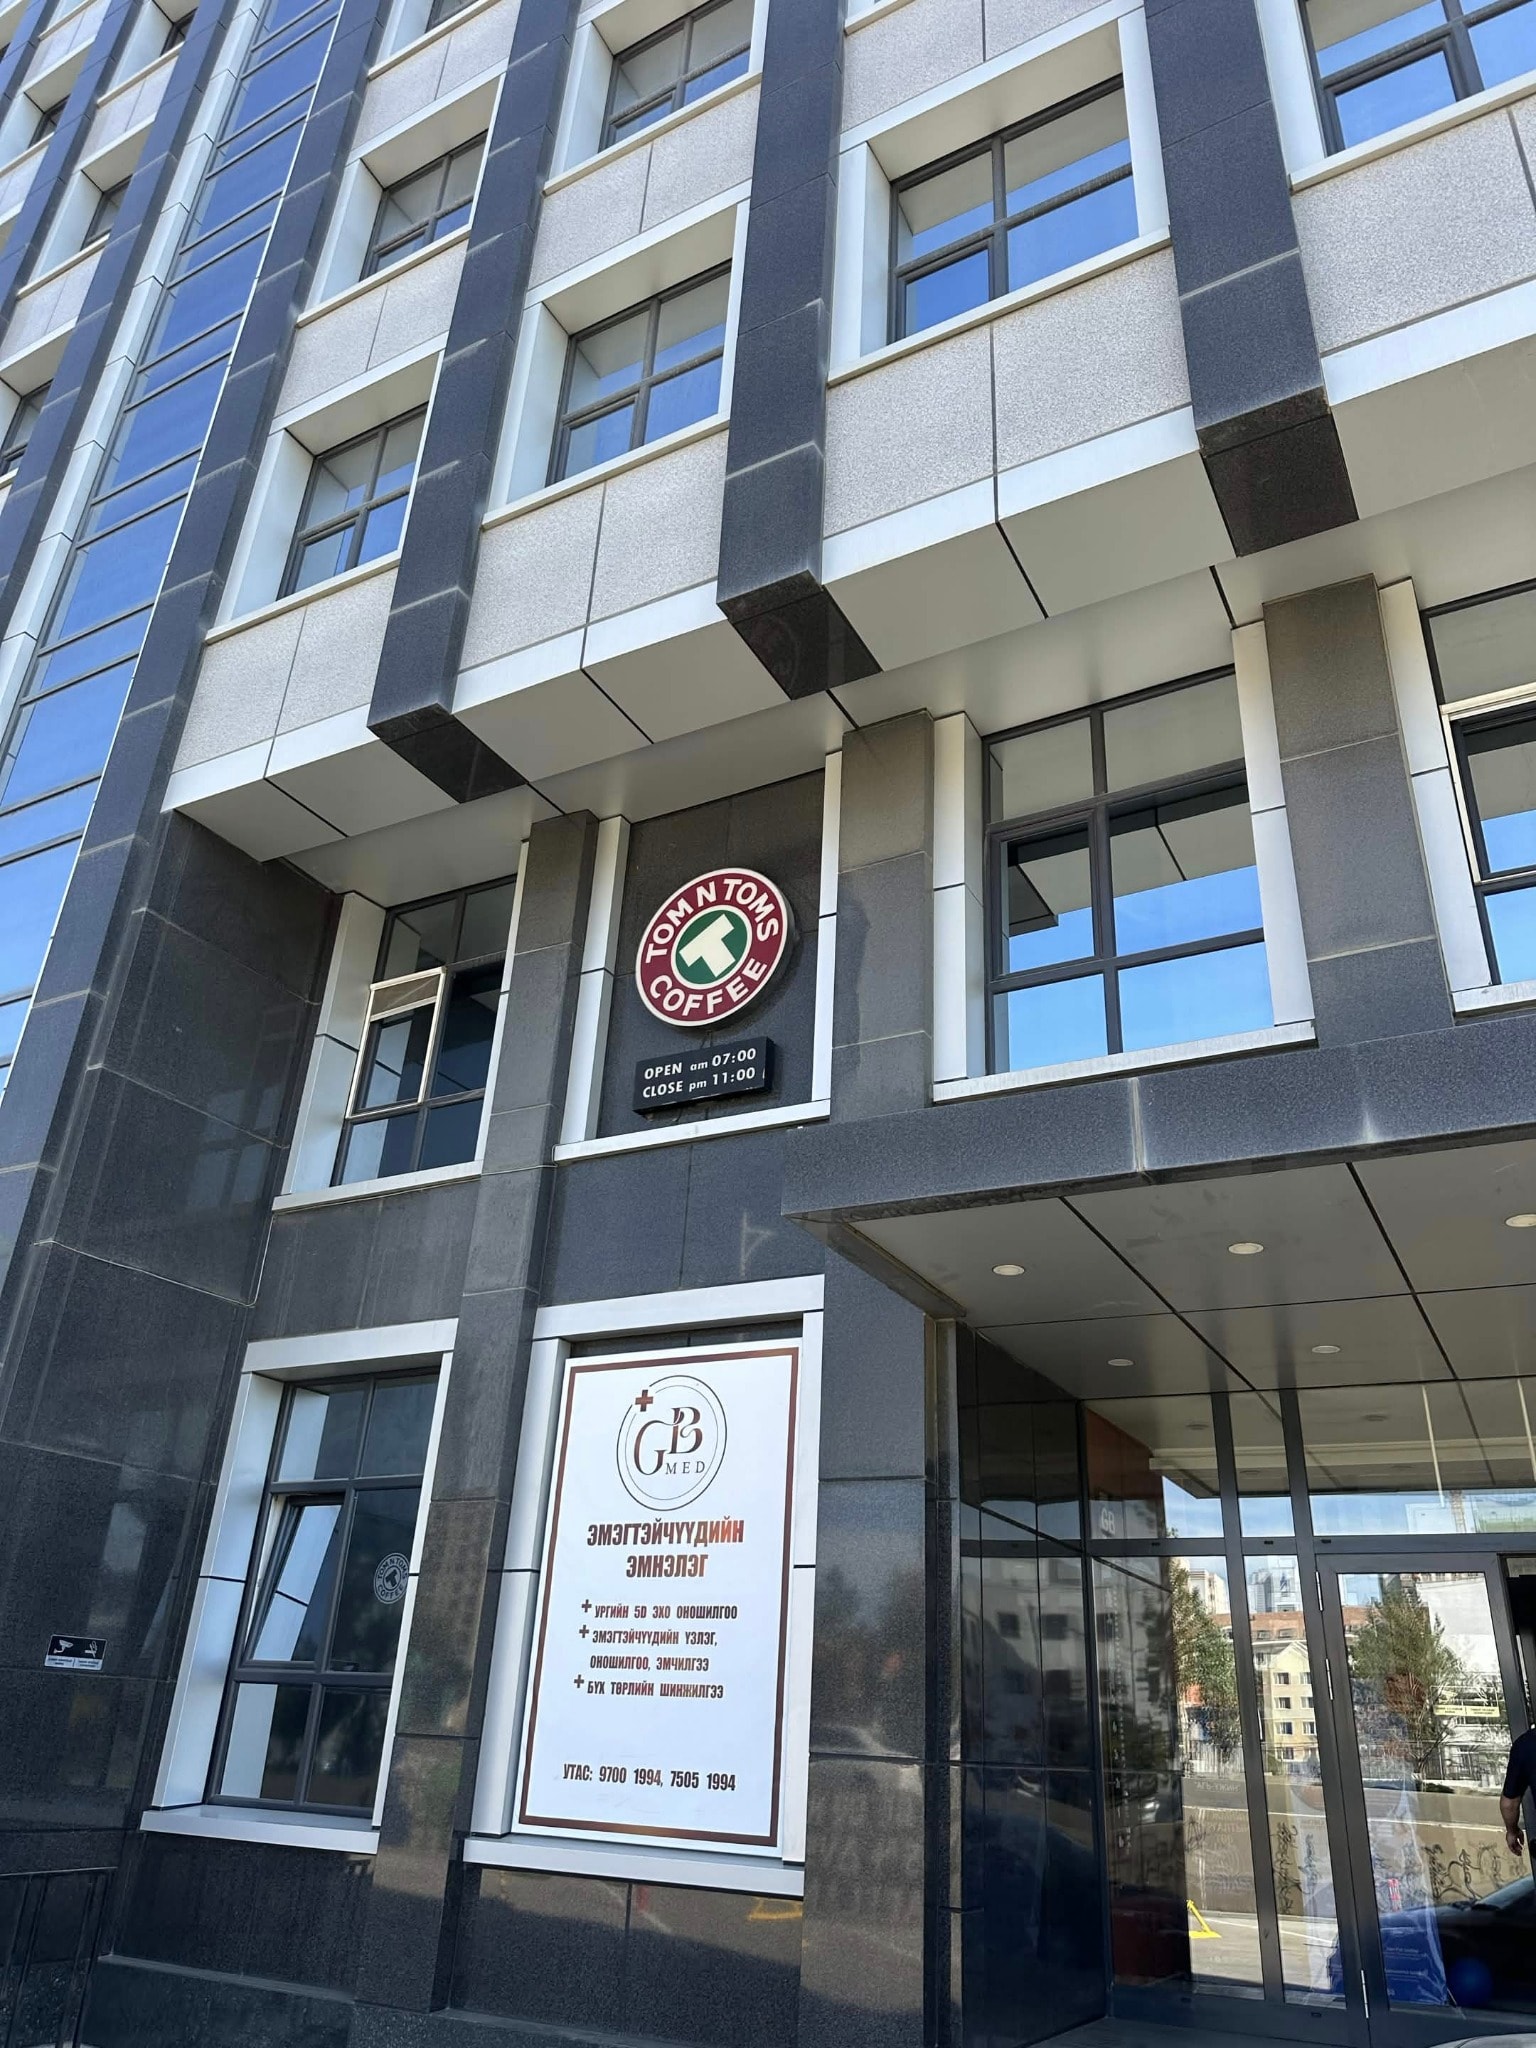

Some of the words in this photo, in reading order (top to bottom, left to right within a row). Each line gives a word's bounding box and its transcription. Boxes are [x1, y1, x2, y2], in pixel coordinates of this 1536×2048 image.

[645, 897, 694, 963] TOM
[696, 881, 717, 907] N
[723, 878, 779, 942] TOMS
[649, 958, 767, 1016] COFFEE
[644, 1062, 683, 1080] OPEN
[690, 1061, 708, 1071] am
[712, 1048, 756, 1067] 07:00
[642, 1081, 683, 1098] CLOSE
[689, 1079, 707, 1093] pm
[712, 1067, 756, 1085] 11:00
[633, 1406, 703, 1476] GB
[665, 1460, 706, 1475] MED
[587, 1515, 745, 1547] ЭМЭГТЭЙЧҮҮДИЙН
[626, 1554, 709, 1578] ЭМНЭЛЭГ
[594, 1603, 629, 1619] УРГИЙН
[634, 1605, 647, 1618] 5D
[652, 1605, 671, 1619] ЭХО
[676, 1605, 738, 1619] ОНОШИЛГОО
[592, 1629, 679, 1646] ЭМЭГТЭЙЧҮҮДИЙН
[685, 1631, 717, 1646] ҮЗЛЭГ,
[590, 1655, 651, 1671] ОНОШИЛГОО,
[656, 1657, 709, 1671] ЭМЧИЛГЭЭ
[587, 1681, 605, 1695] БҮХ
[610, 1680, 654, 1696] ТӨРЛИЙН
[660, 1683, 724, 1699] ШИНЖИЛГЭЭ
[562, 1763, 593, 1781] УТАС:
[599, 1765, 627, 1783] 9700
[633, 1768, 663, 1788] 1994,
[670, 1770, 699, 1789] 7505
[706, 1773, 736, 1791] 1994
